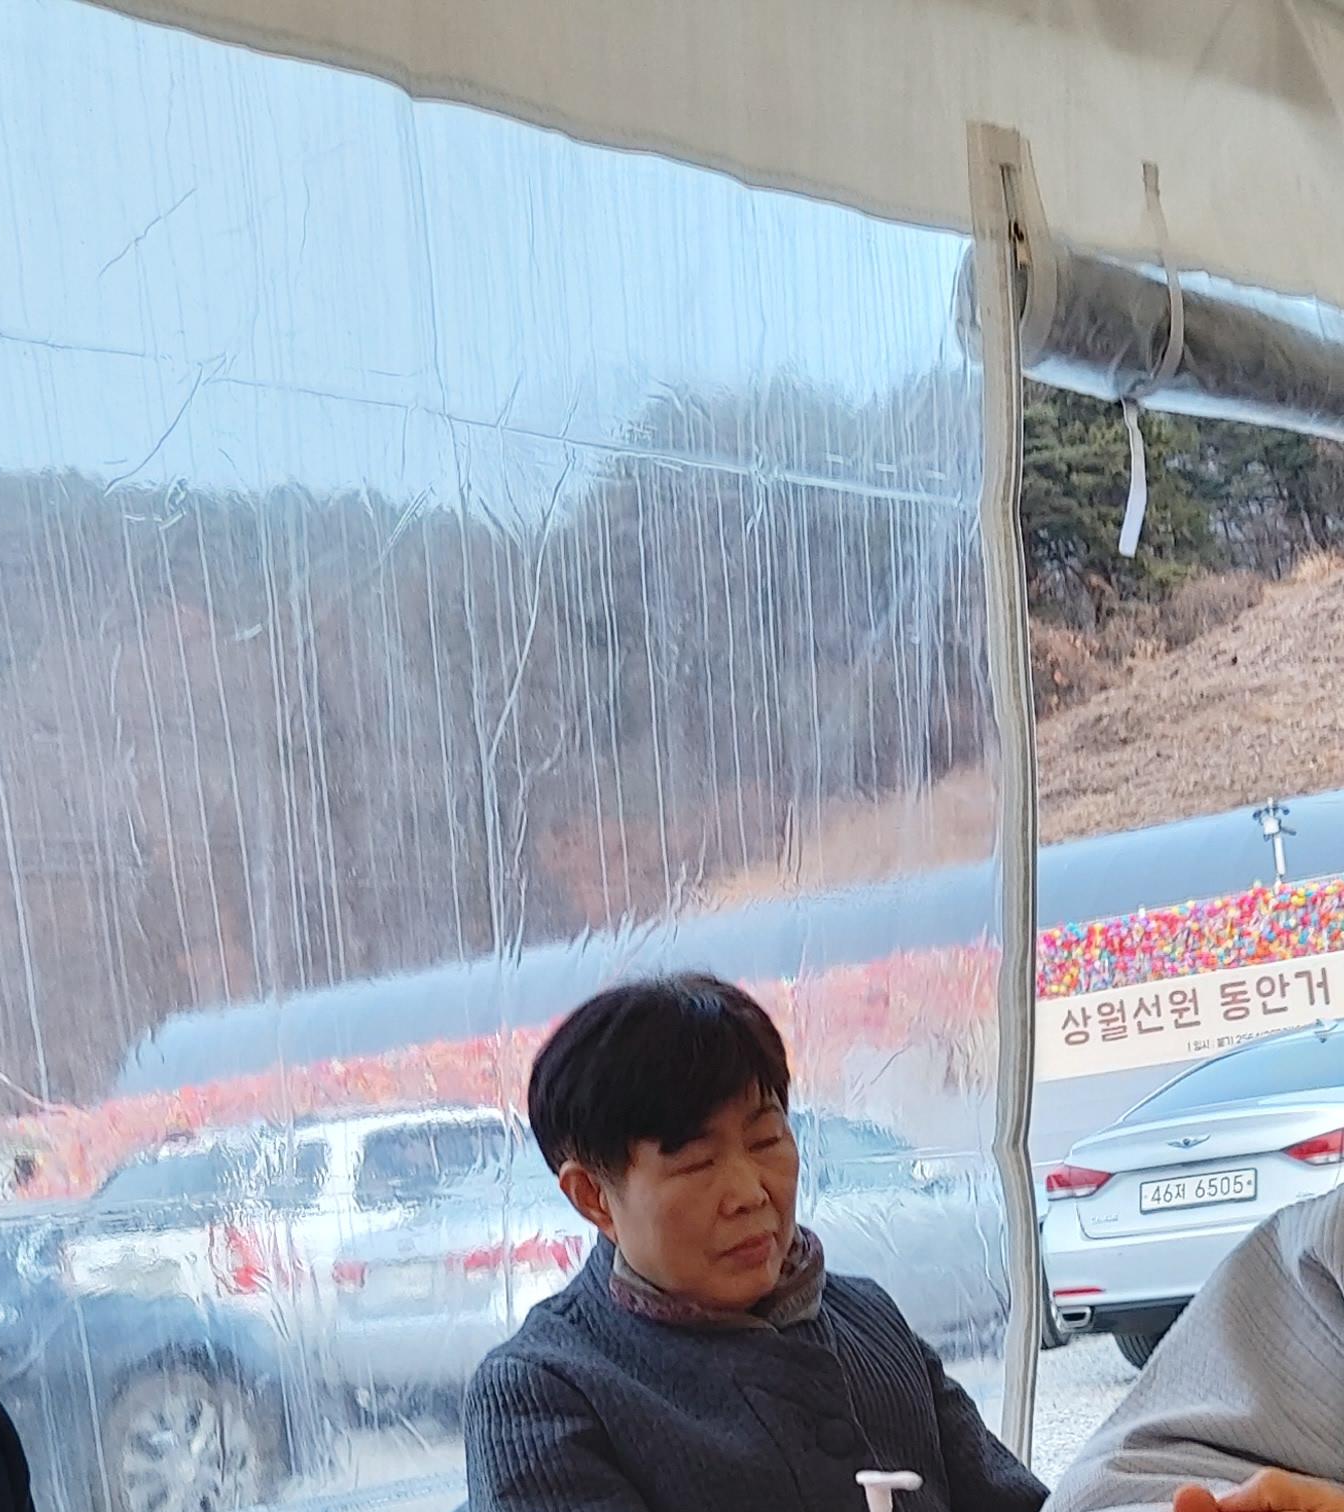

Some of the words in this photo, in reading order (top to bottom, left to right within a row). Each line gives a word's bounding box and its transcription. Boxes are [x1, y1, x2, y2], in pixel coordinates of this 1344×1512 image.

[1061, 988, 1201, 1045] 상월선원
[1219, 966, 1332, 1021] 동안거
[1150, 1183, 1186, 1204] 46저
[1194, 1174, 1244, 1198] 6505
